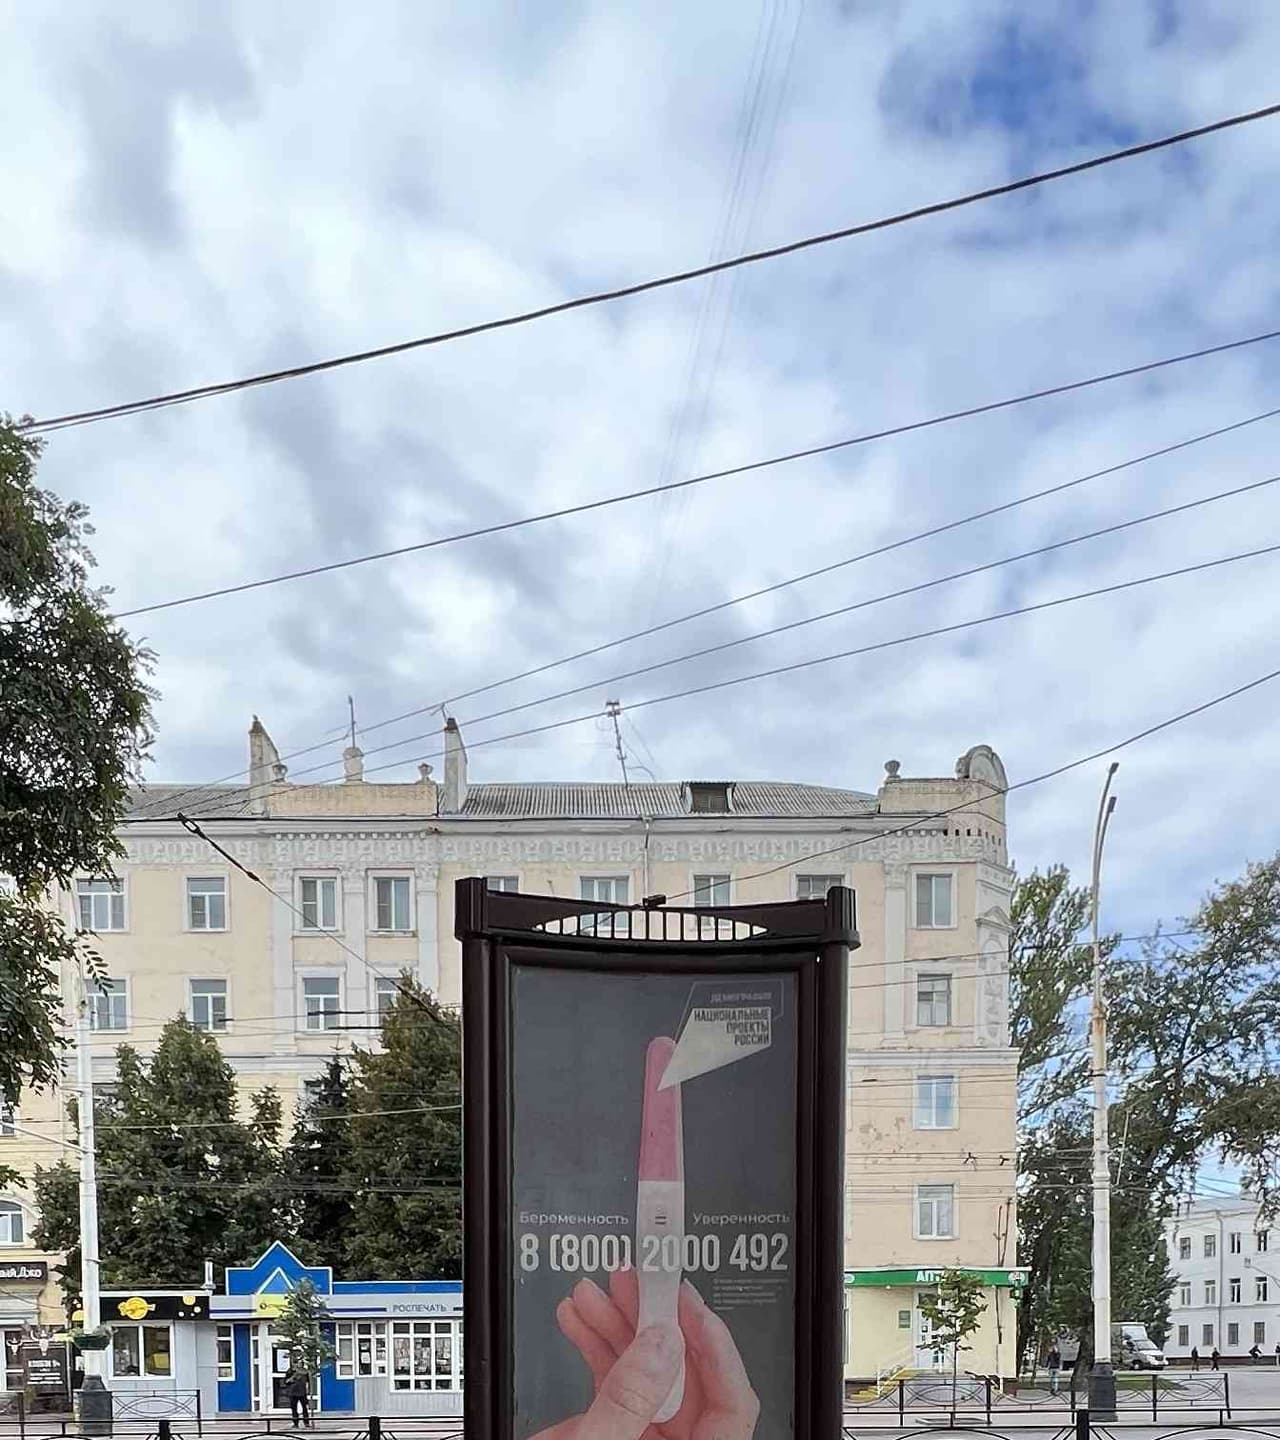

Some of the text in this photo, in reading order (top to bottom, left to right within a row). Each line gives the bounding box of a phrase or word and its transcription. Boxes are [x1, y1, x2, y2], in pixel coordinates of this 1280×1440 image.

[694, 1009, 770, 1021] НАЦИОНАЛЬНЫЕ
[726, 1021, 770, 1034] ПРОЕКТЫ
[734, 1034, 769, 1046] РОССИИ
[520, 1211, 629, 1226] Беременность
[693, 1212, 790, 1227] Уверенность
[520, 1233, 789, 1273] 8 (800) 2000 492
[393, 1304, 447, 1313] РОСПЕЧАТЬ
